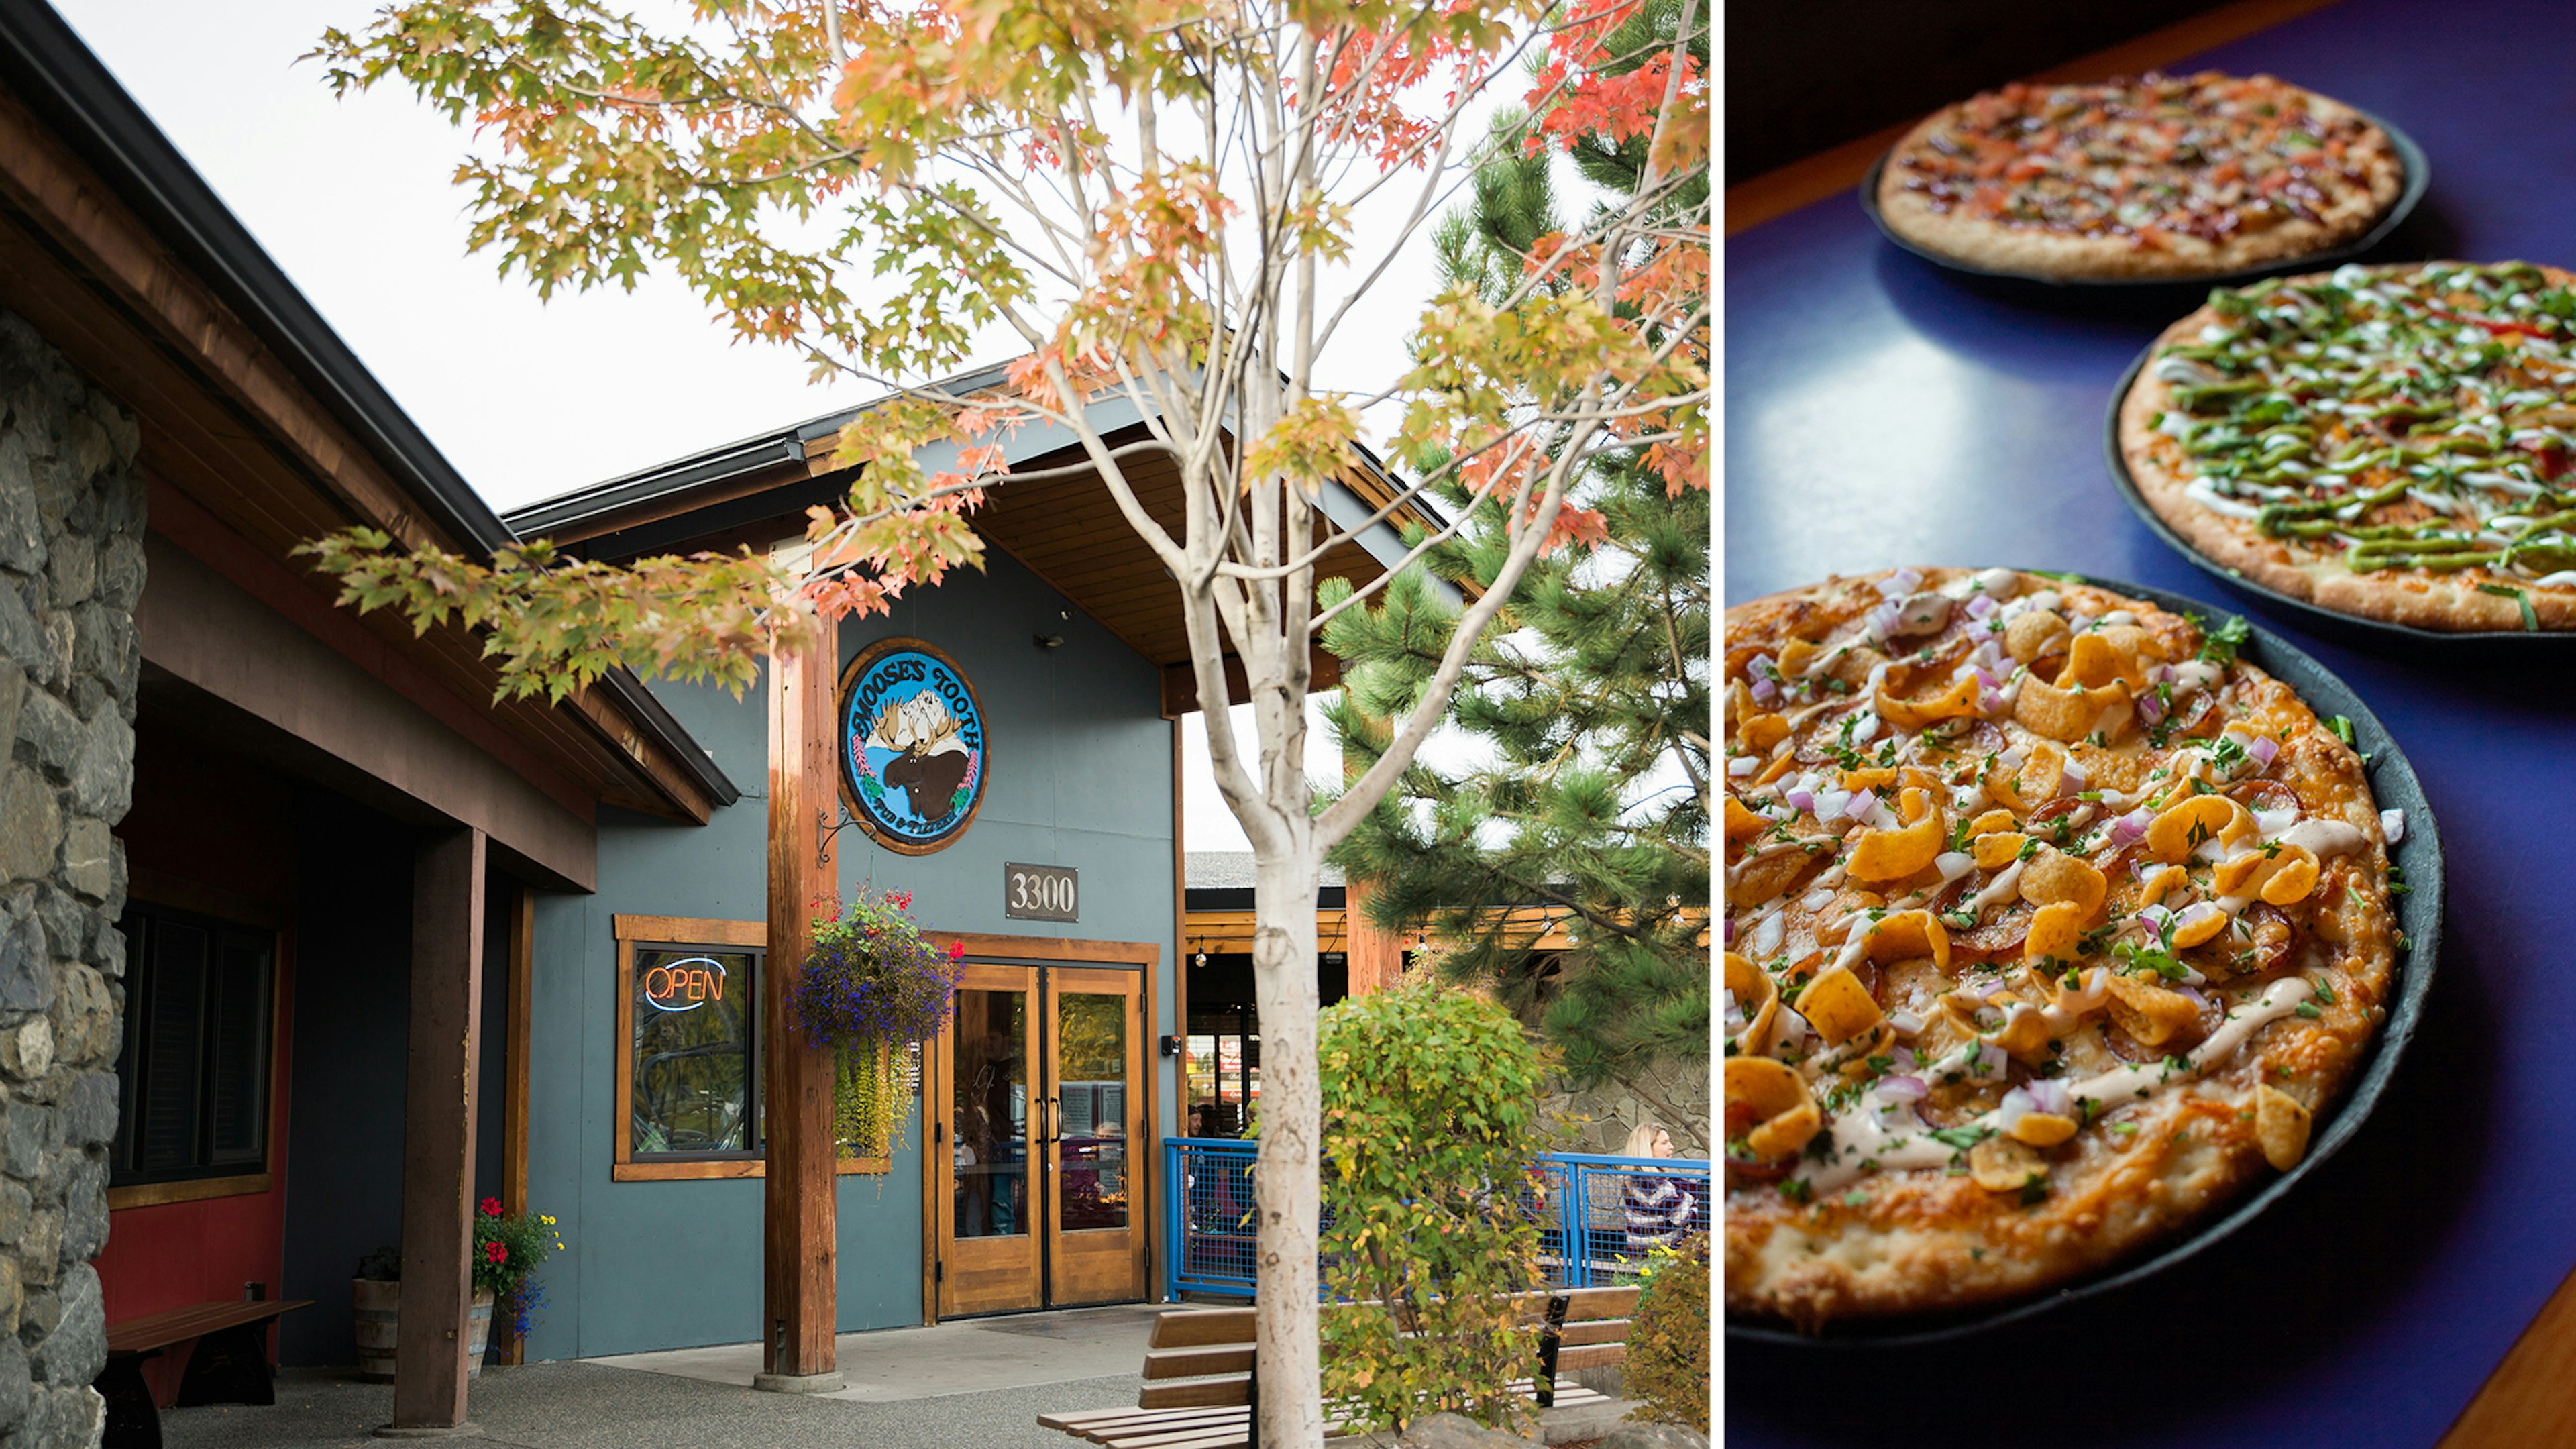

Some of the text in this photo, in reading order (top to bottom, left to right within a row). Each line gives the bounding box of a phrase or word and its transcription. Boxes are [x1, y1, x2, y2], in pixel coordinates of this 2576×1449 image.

[933, 668, 979, 750] TOOTH
[1011, 873, 1075, 912] 3300
[645, 967, 724, 1000] OPEN
